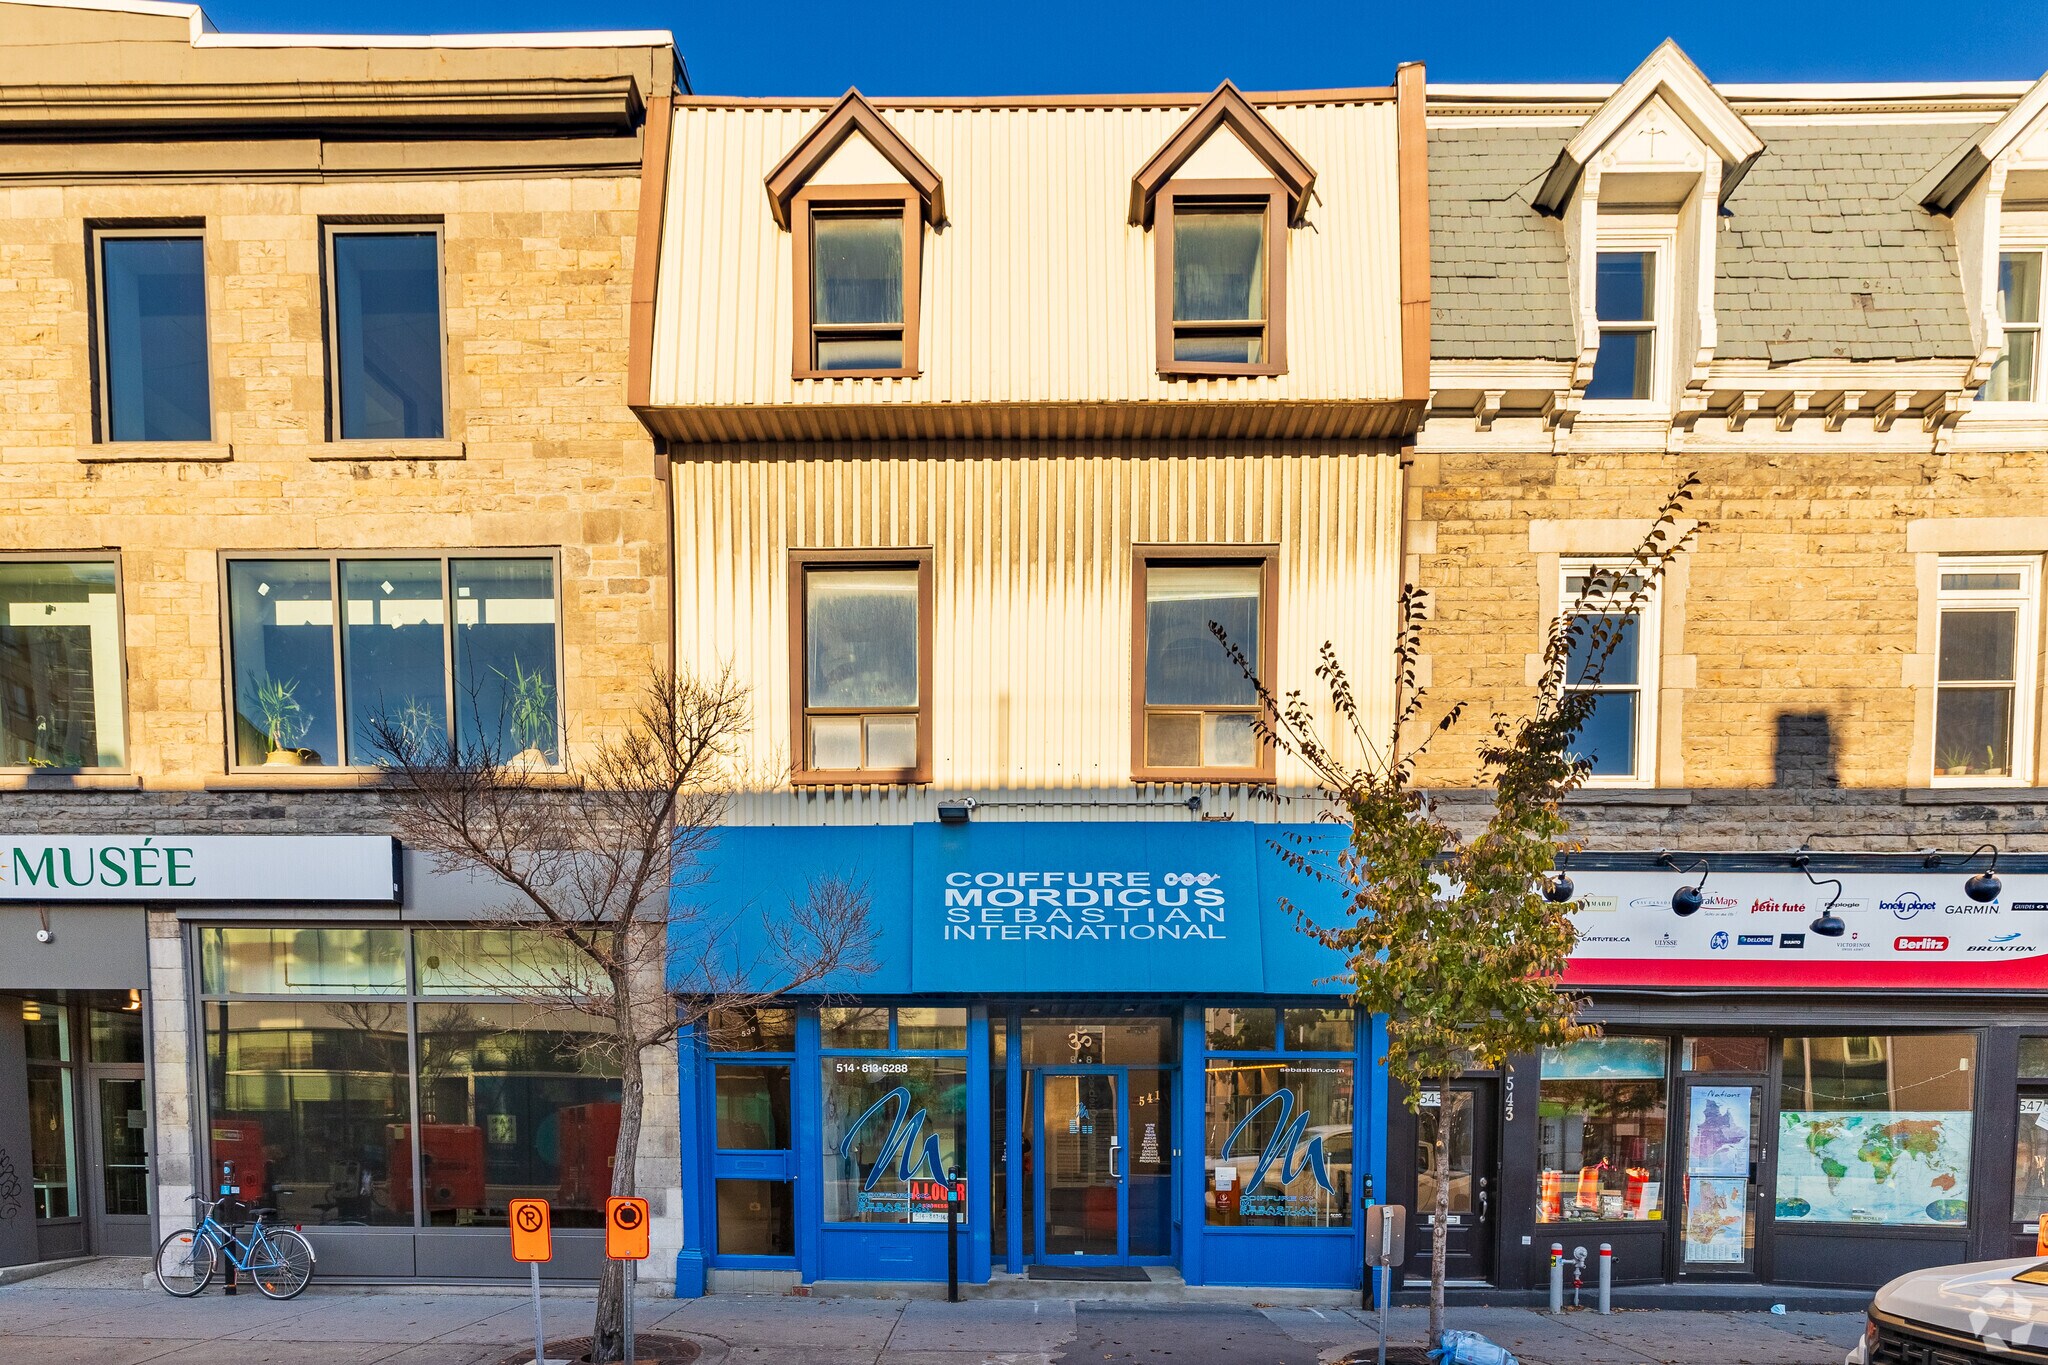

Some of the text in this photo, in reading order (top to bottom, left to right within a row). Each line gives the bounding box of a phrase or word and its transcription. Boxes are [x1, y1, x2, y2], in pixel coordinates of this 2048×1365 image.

[13, 838, 196, 888] MUSÉE
[945, 872, 1151, 887] COIFFURE
[944, 888, 1226, 907] MORDICUS
[1700, 896, 1738, 906] rakMaps
[1782, 901, 1806, 913] futé
[1879, 900, 1936, 912] lonely planet
[1945, 905, 1999, 915] GARMIN
[946, 908, 1226, 923] SEBASTIAN
[944, 925, 1227, 940] INTERNATIONAL
[1898, 938, 1945, 950] Berlitz
[741, 1026, 756, 1037] 539
[1139, 1090, 1160, 1106] 541
[1707, 1089, 1741, 1098] Nations
[2020, 1100, 2043, 1111] 547
[923, 1182, 965, 1201] LOUR
